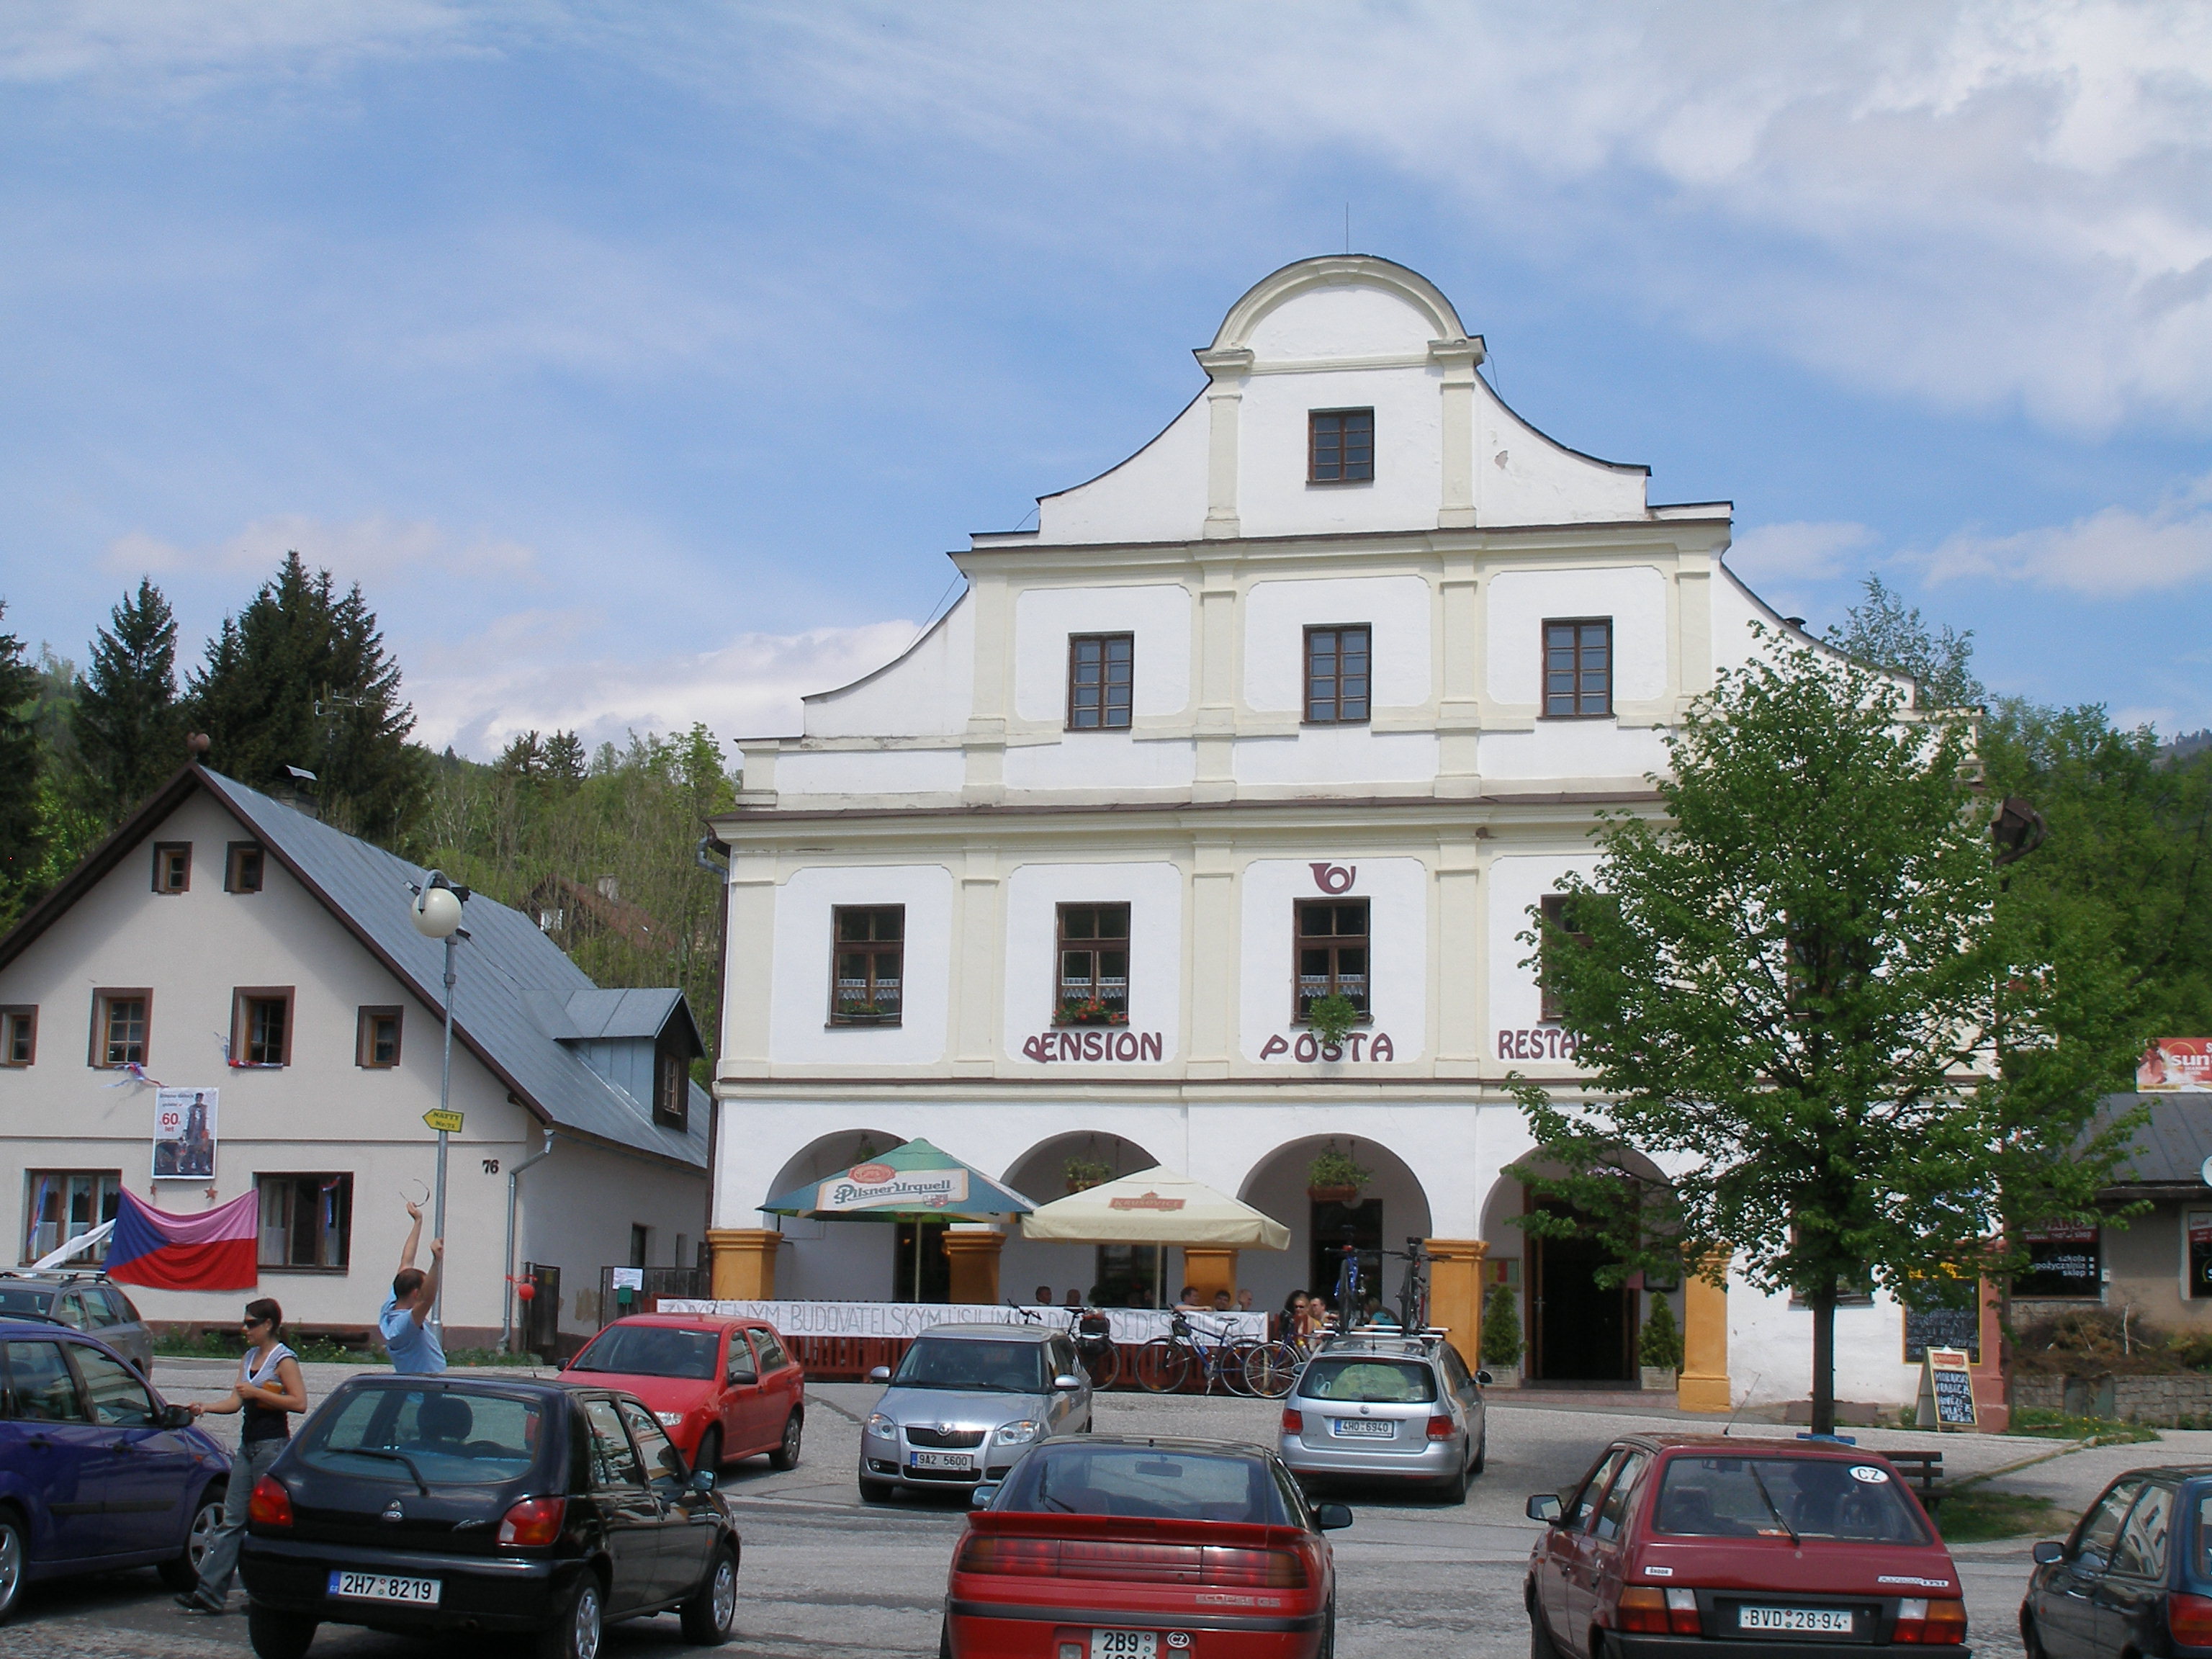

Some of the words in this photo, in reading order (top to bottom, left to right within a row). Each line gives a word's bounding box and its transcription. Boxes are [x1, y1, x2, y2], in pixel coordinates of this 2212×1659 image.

[1022, 1032, 1162, 1063] PENSION
[162, 1112, 179, 1125] 60
[482, 1159, 500, 1174] 76
[833, 1184, 895, 1205] Pilsner
[894, 1179, 950, 1195] Urquell
[1365, 1423, 1388, 1432] 6940
[919, 1455, 936, 1464] 9A2
[944, 1456, 967, 1466] 5600
[1857, 1467, 1881, 1481] CZ
[343, 1575, 375, 1594] 2H7
[388, 1578, 431, 1600] 8219
[1750, 1609, 1782, 1627] BVD
[1102, 1632, 1139, 1653] 2B9
[1170, 1634, 1185, 1645] CZ
